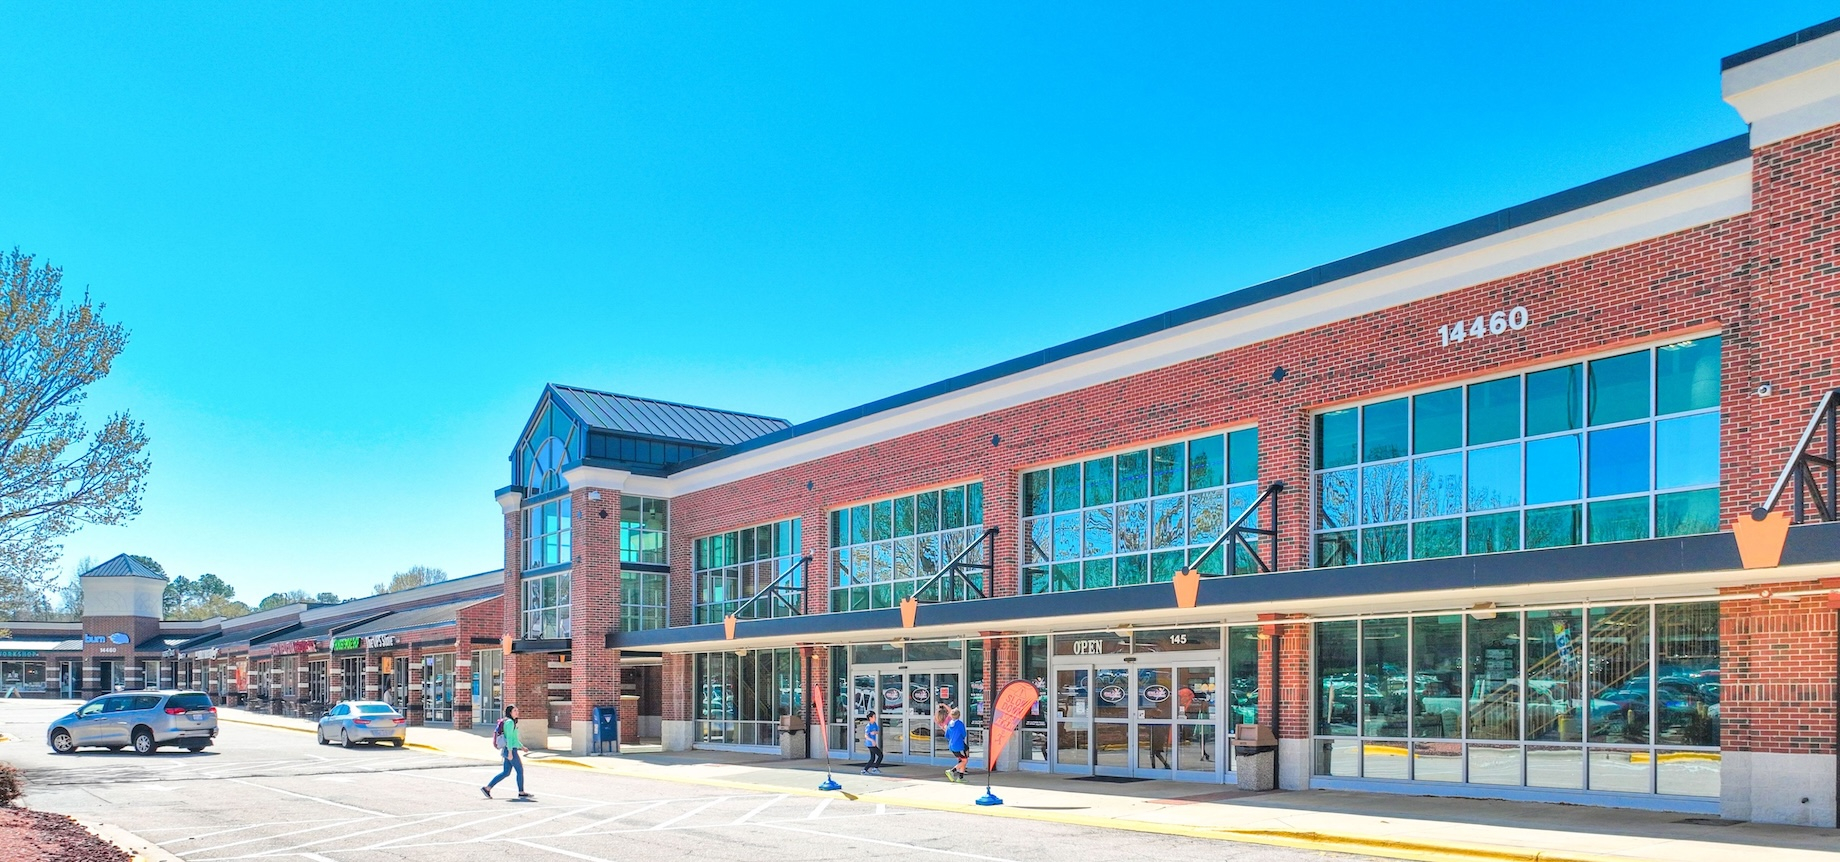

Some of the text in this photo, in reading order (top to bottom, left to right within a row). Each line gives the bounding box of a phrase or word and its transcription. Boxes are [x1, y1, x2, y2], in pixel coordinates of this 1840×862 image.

[1438, 306, 1529, 347] 14460
[1073, 639, 1103, 655] OPEN
[1169, 634, 1187, 644] 145
